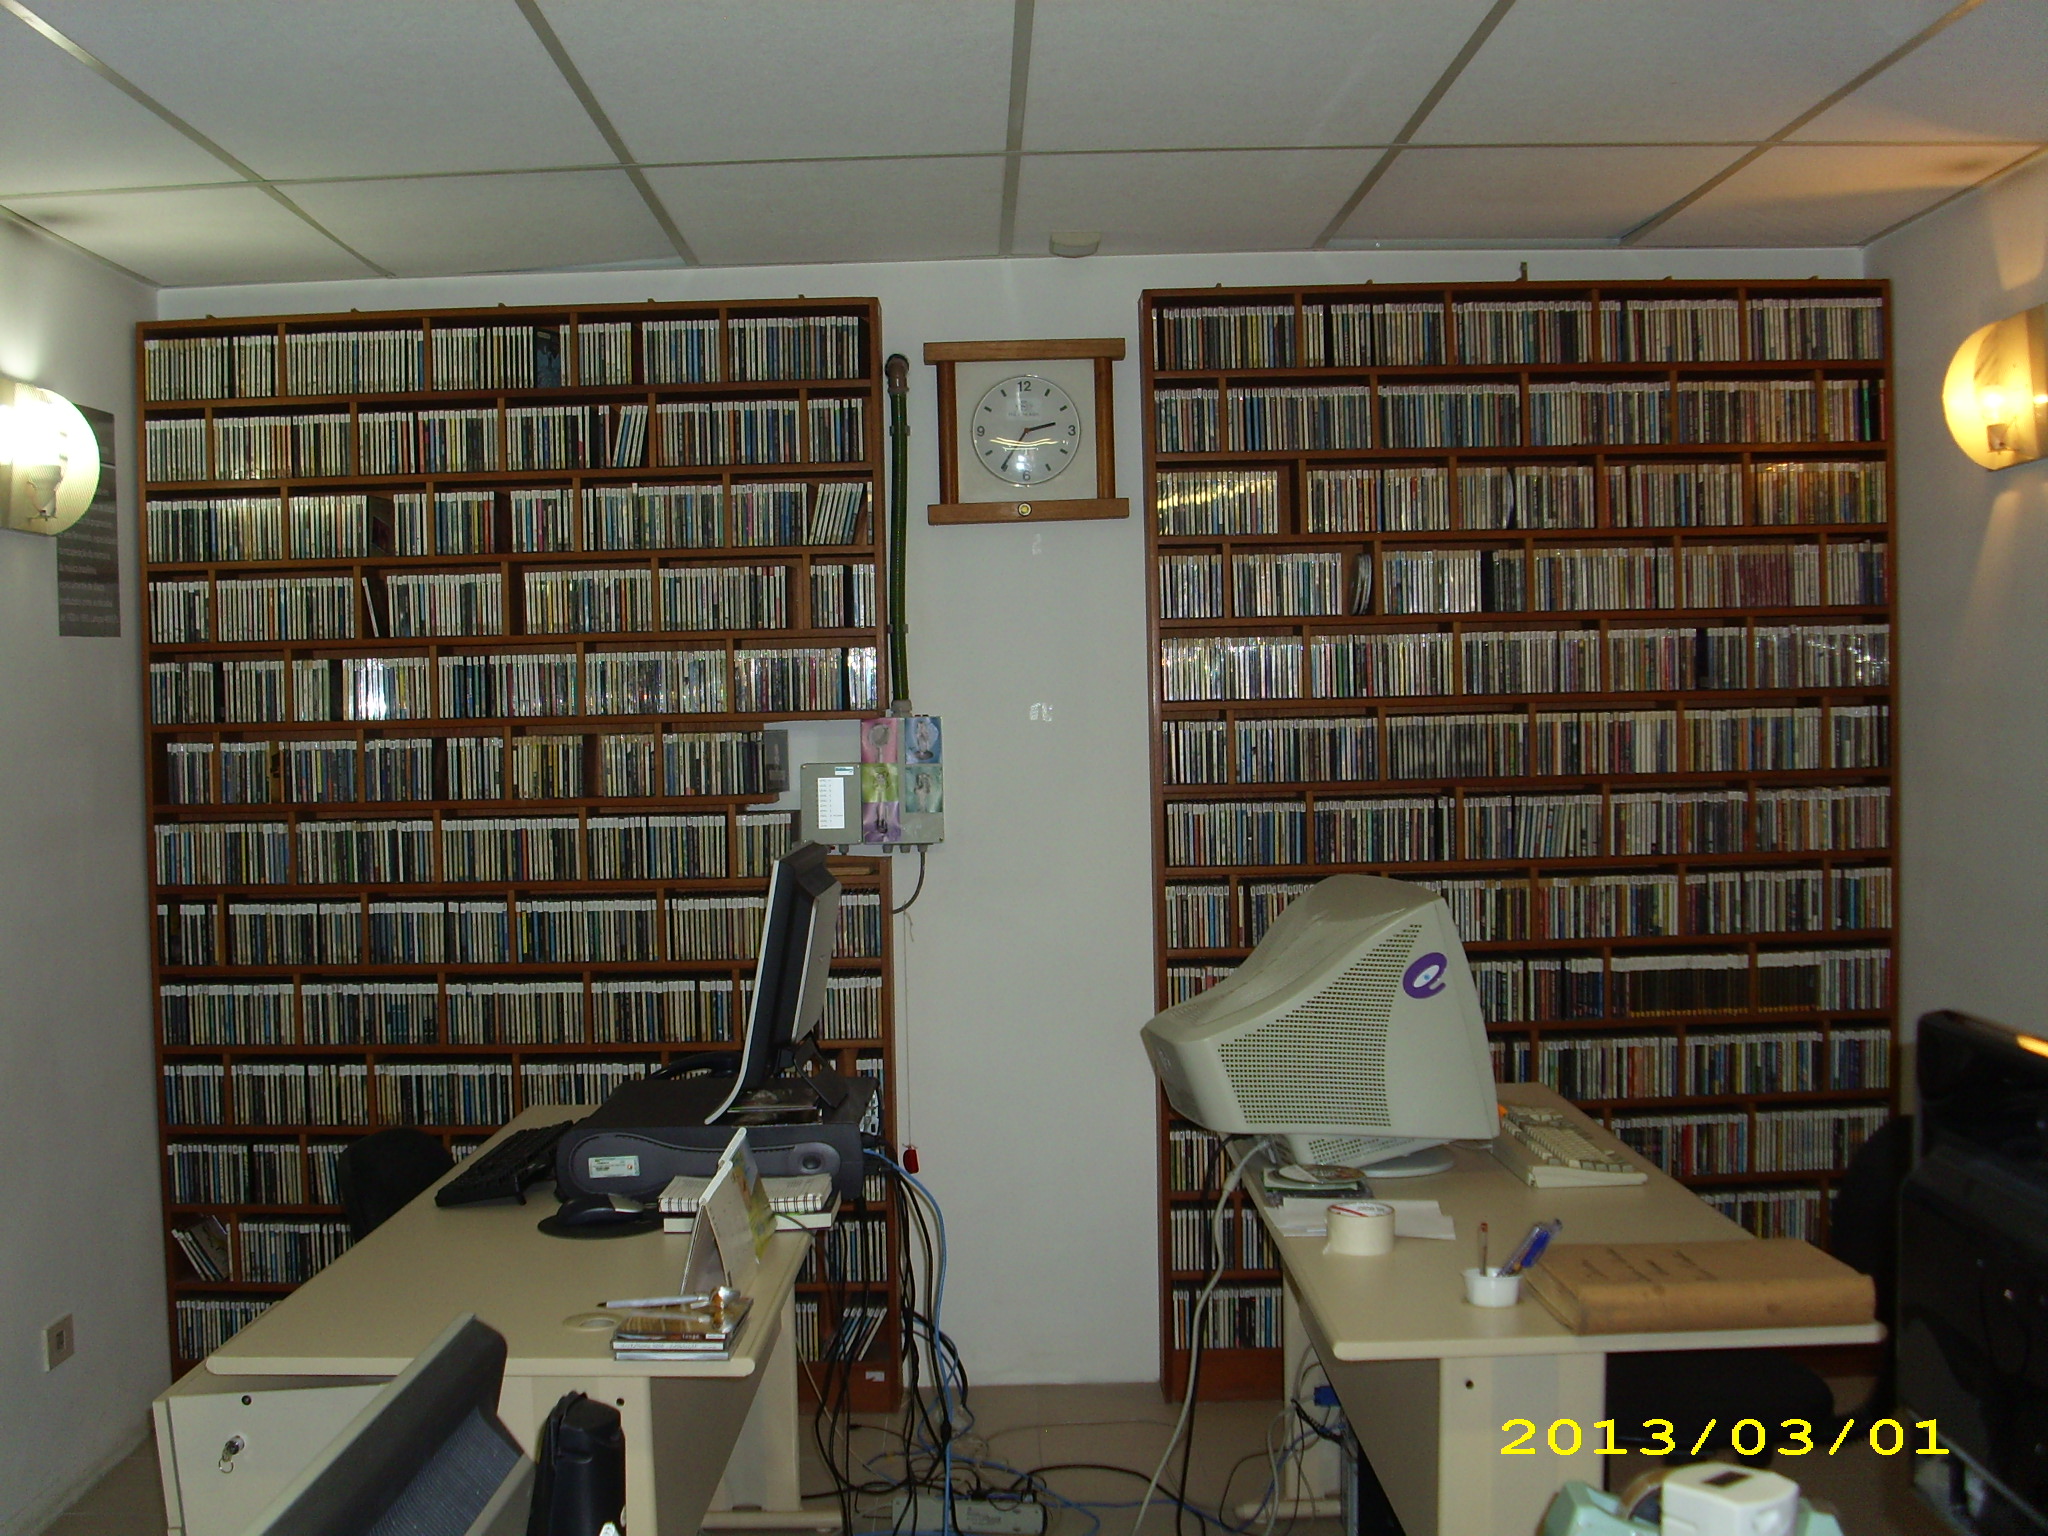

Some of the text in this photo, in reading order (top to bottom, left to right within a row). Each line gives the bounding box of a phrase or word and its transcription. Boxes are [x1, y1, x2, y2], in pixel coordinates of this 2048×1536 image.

[1017, 380, 1032, 392] 12
[976, 425, 986, 437] 9
[1067, 424, 1077, 437] 3
[1022, 470, 1031, 481] 6
